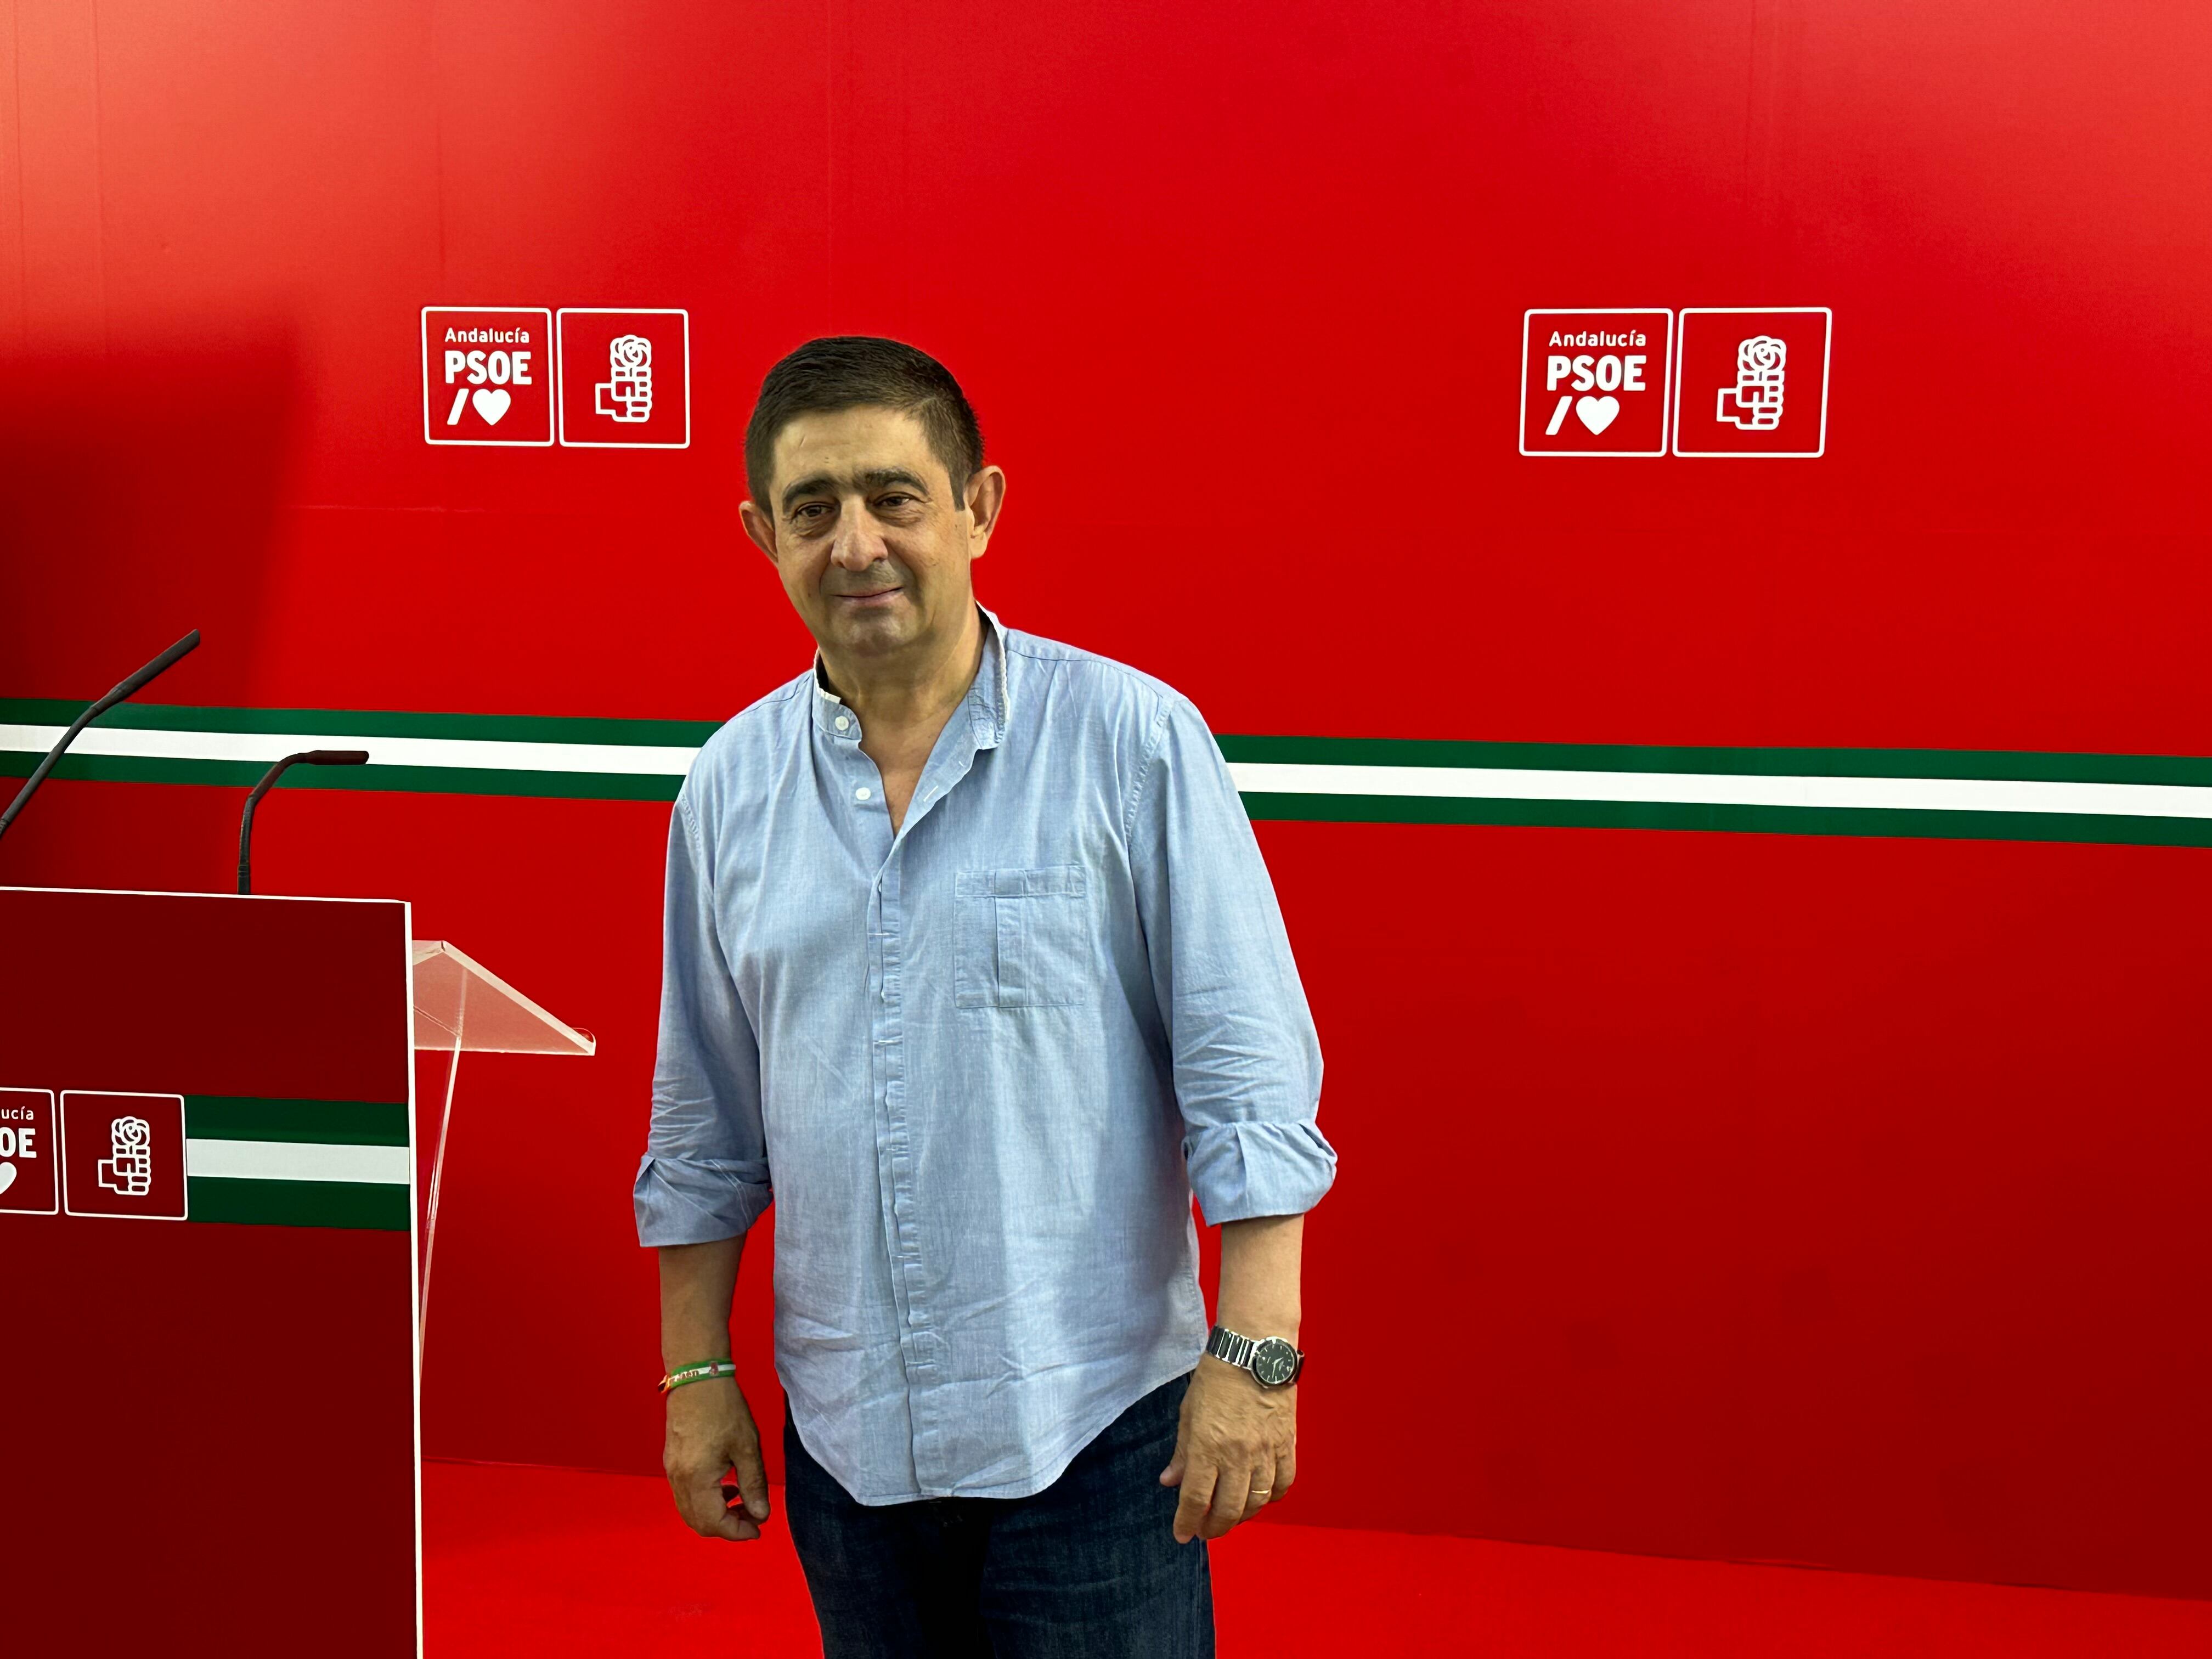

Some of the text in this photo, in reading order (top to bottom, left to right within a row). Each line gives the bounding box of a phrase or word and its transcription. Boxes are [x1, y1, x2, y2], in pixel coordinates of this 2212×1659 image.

[445, 327, 529, 343] Andalucía
[1549, 329, 1646, 347] Andalucía
[445, 350, 532, 385] PSOE
[1547, 354, 1647, 392] PSOE
